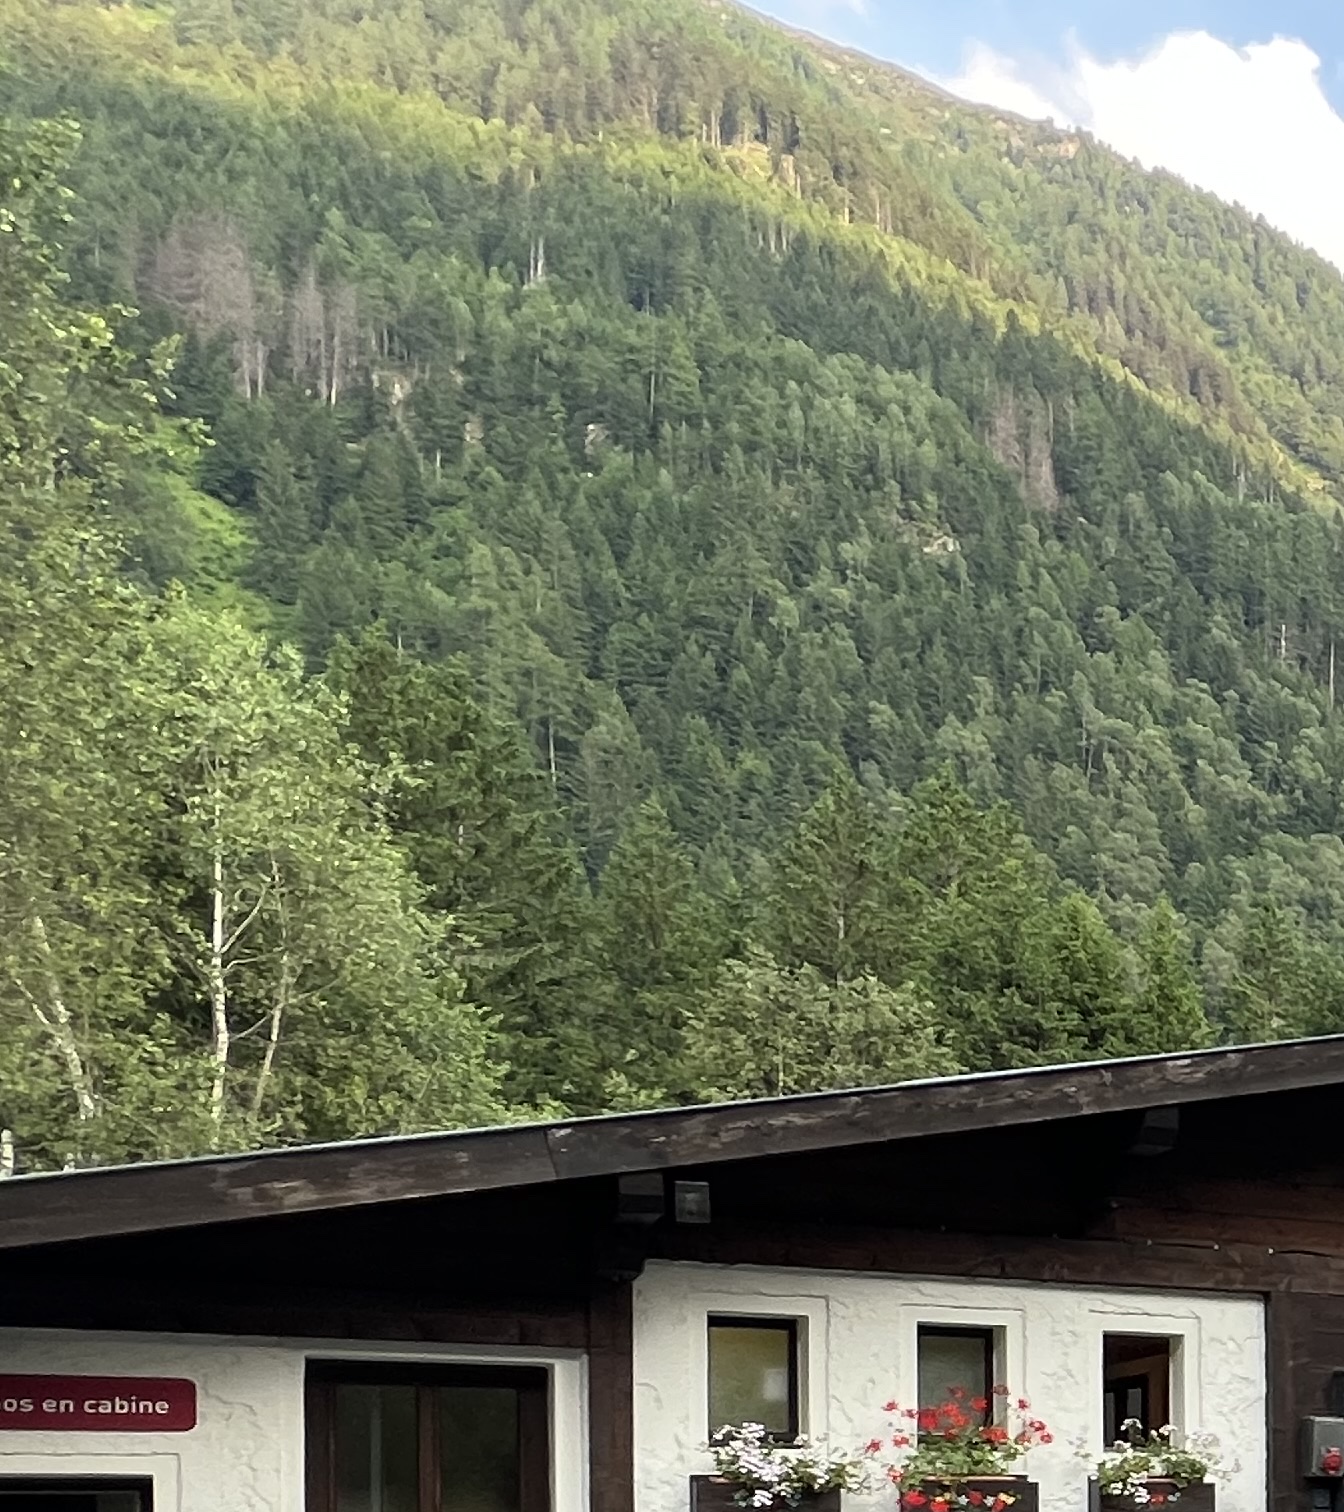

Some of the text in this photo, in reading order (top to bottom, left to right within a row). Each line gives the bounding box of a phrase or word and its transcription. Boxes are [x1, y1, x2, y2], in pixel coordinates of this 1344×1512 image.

[0, 1395, 170, 1414] os en cabine
